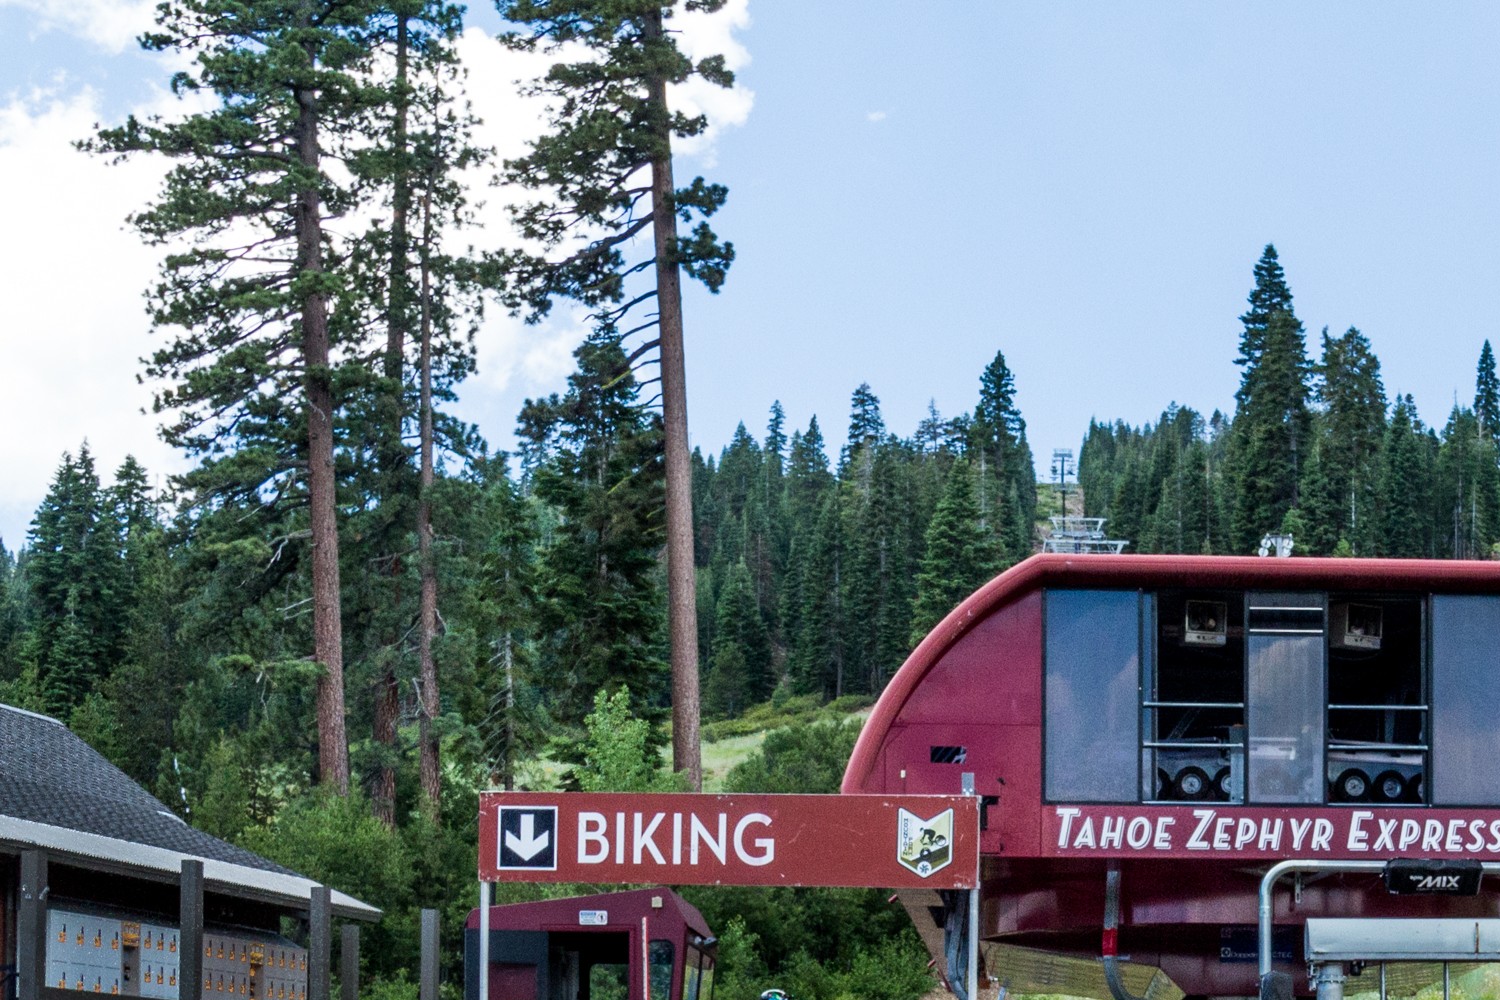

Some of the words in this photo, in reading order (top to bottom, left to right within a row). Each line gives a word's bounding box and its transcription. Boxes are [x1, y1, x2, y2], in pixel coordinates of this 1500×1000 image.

[577, 812, 776, 867] BIKING
[1055, 807, 1176, 850] TAHOE
[1186, 809, 1334, 851] ZEPHYR
